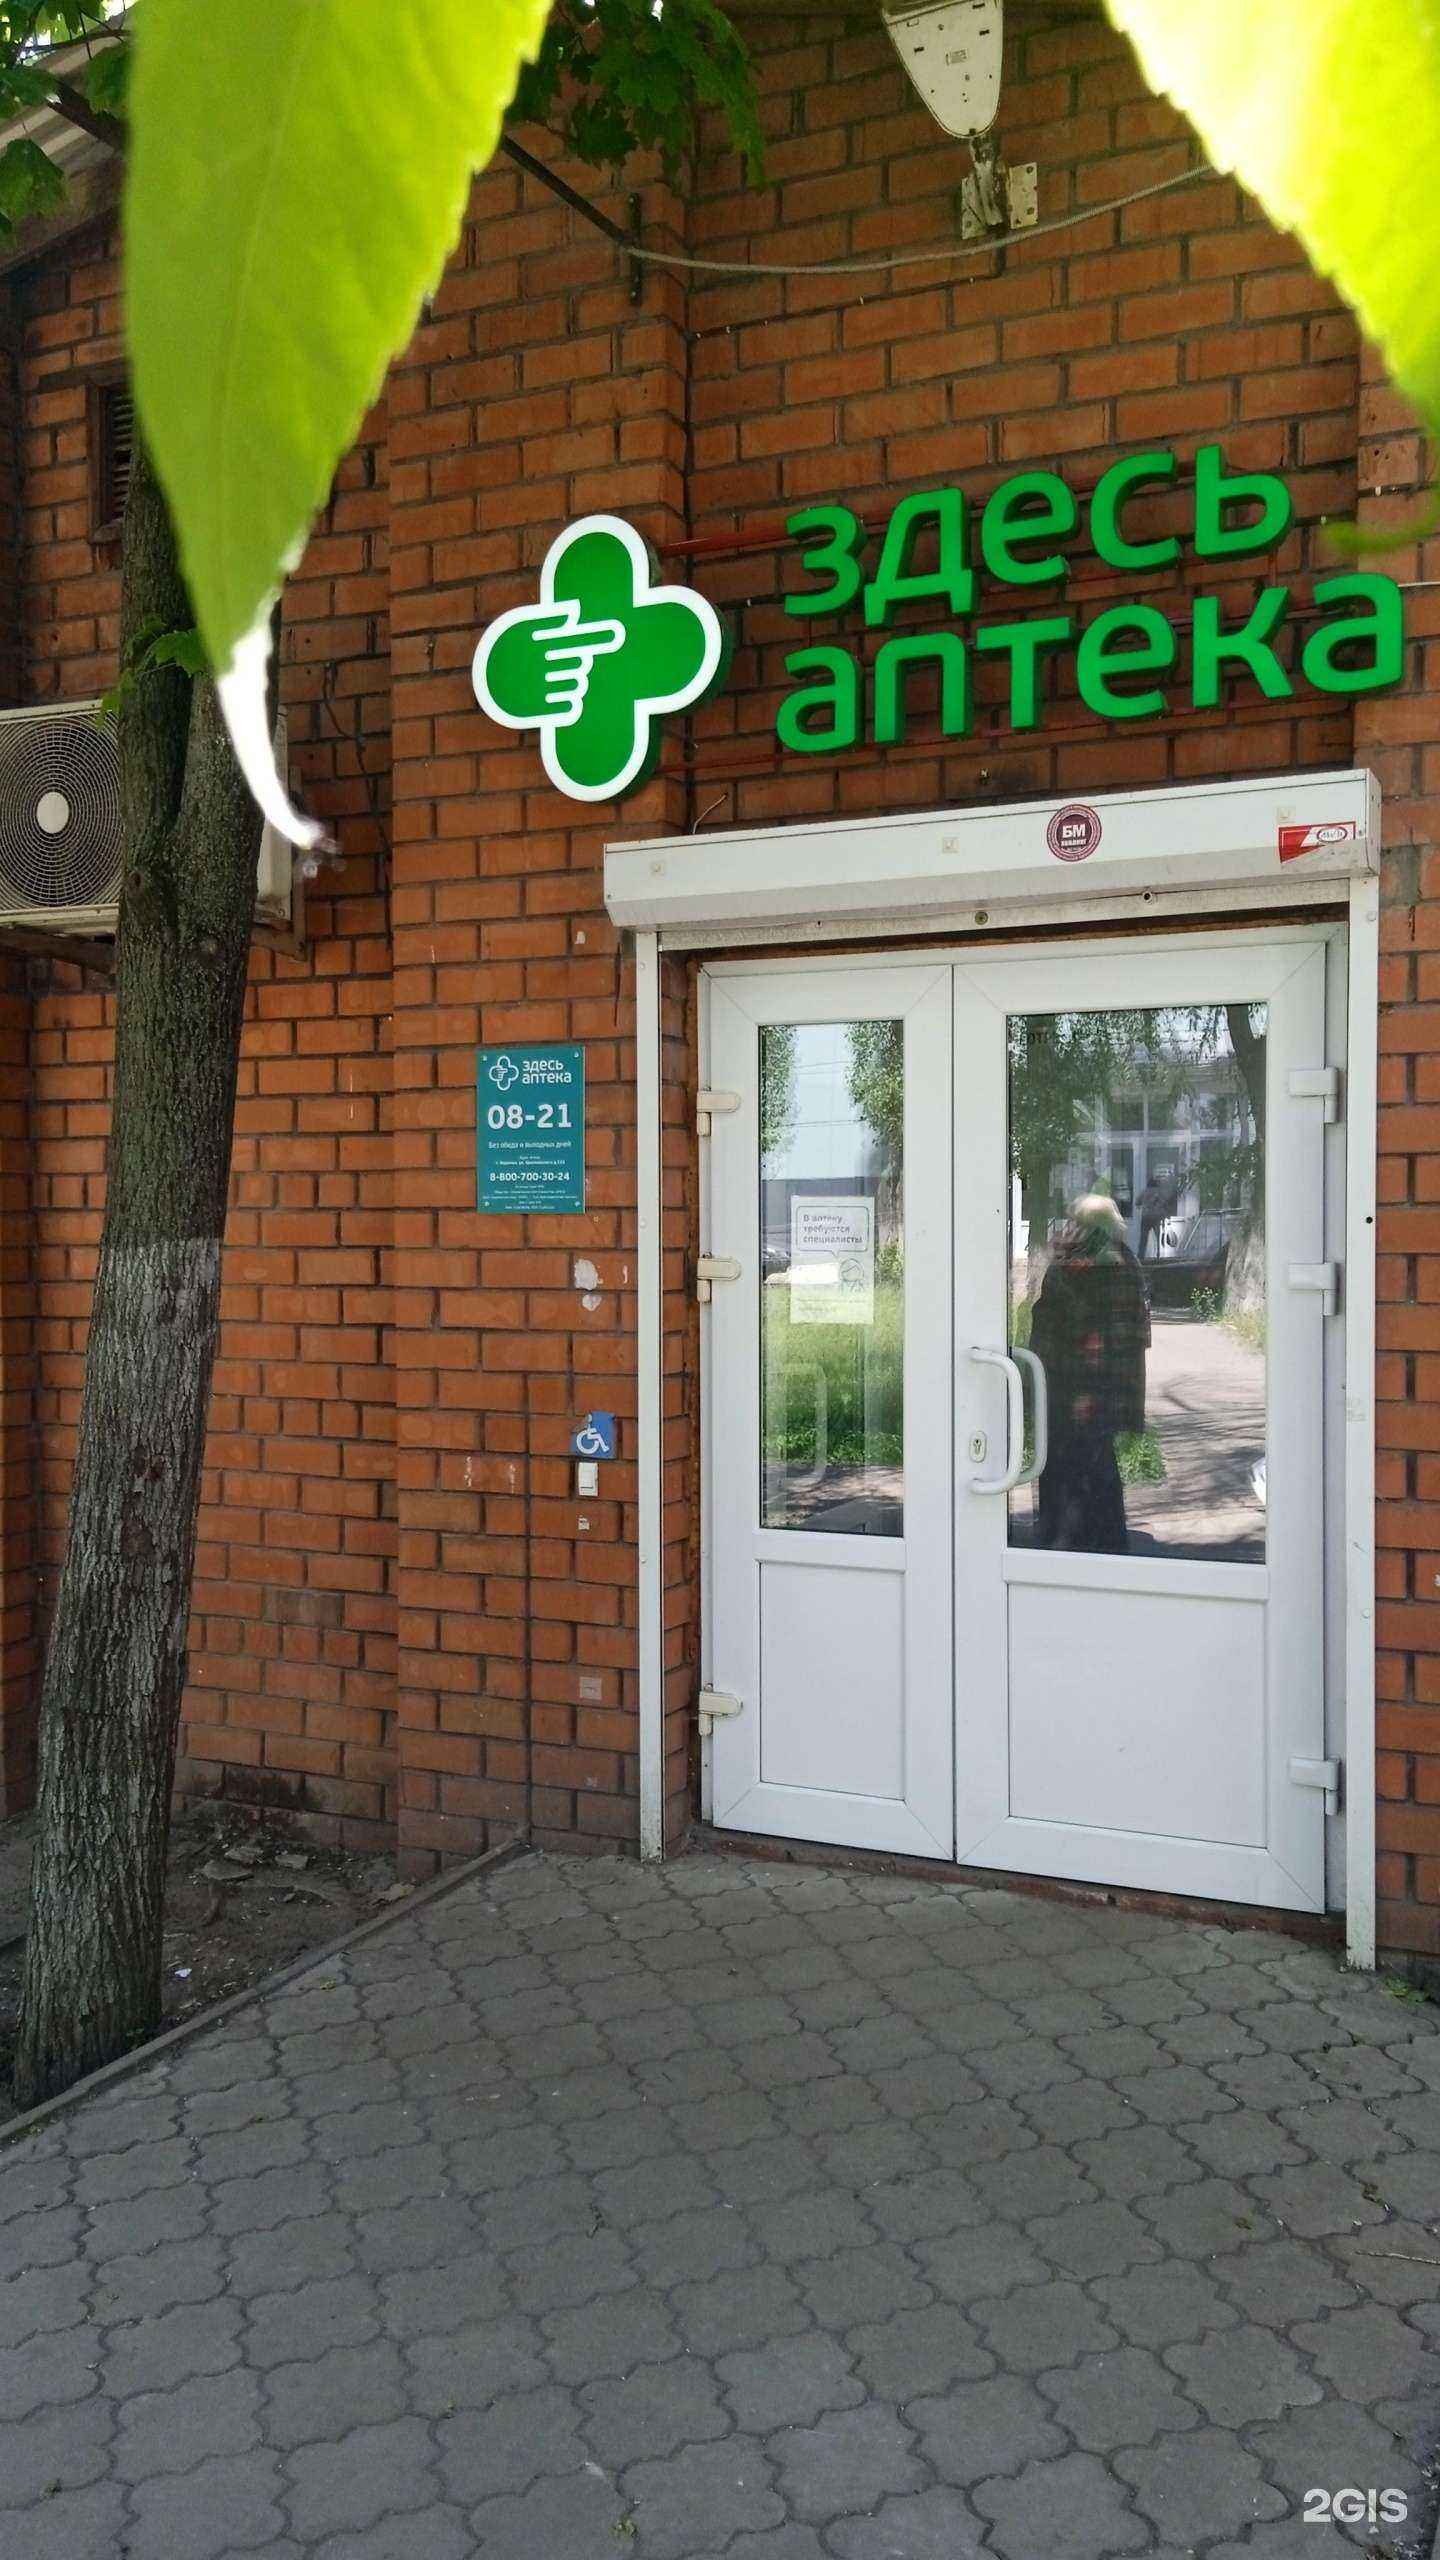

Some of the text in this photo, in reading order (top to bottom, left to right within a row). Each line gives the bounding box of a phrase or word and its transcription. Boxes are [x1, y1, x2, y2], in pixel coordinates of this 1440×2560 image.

[784, 444, 1294, 628] здесь
[776, 572, 1404, 753] аптека
[1062, 824, 1086, 838] БМ
[521, 1059, 564, 1073] здесь
[521, 1071, 572, 1084] аптека
[487, 1103, 572, 1130] 08-21
[489, 1172, 570, 1181] 8-800-700-30-24
